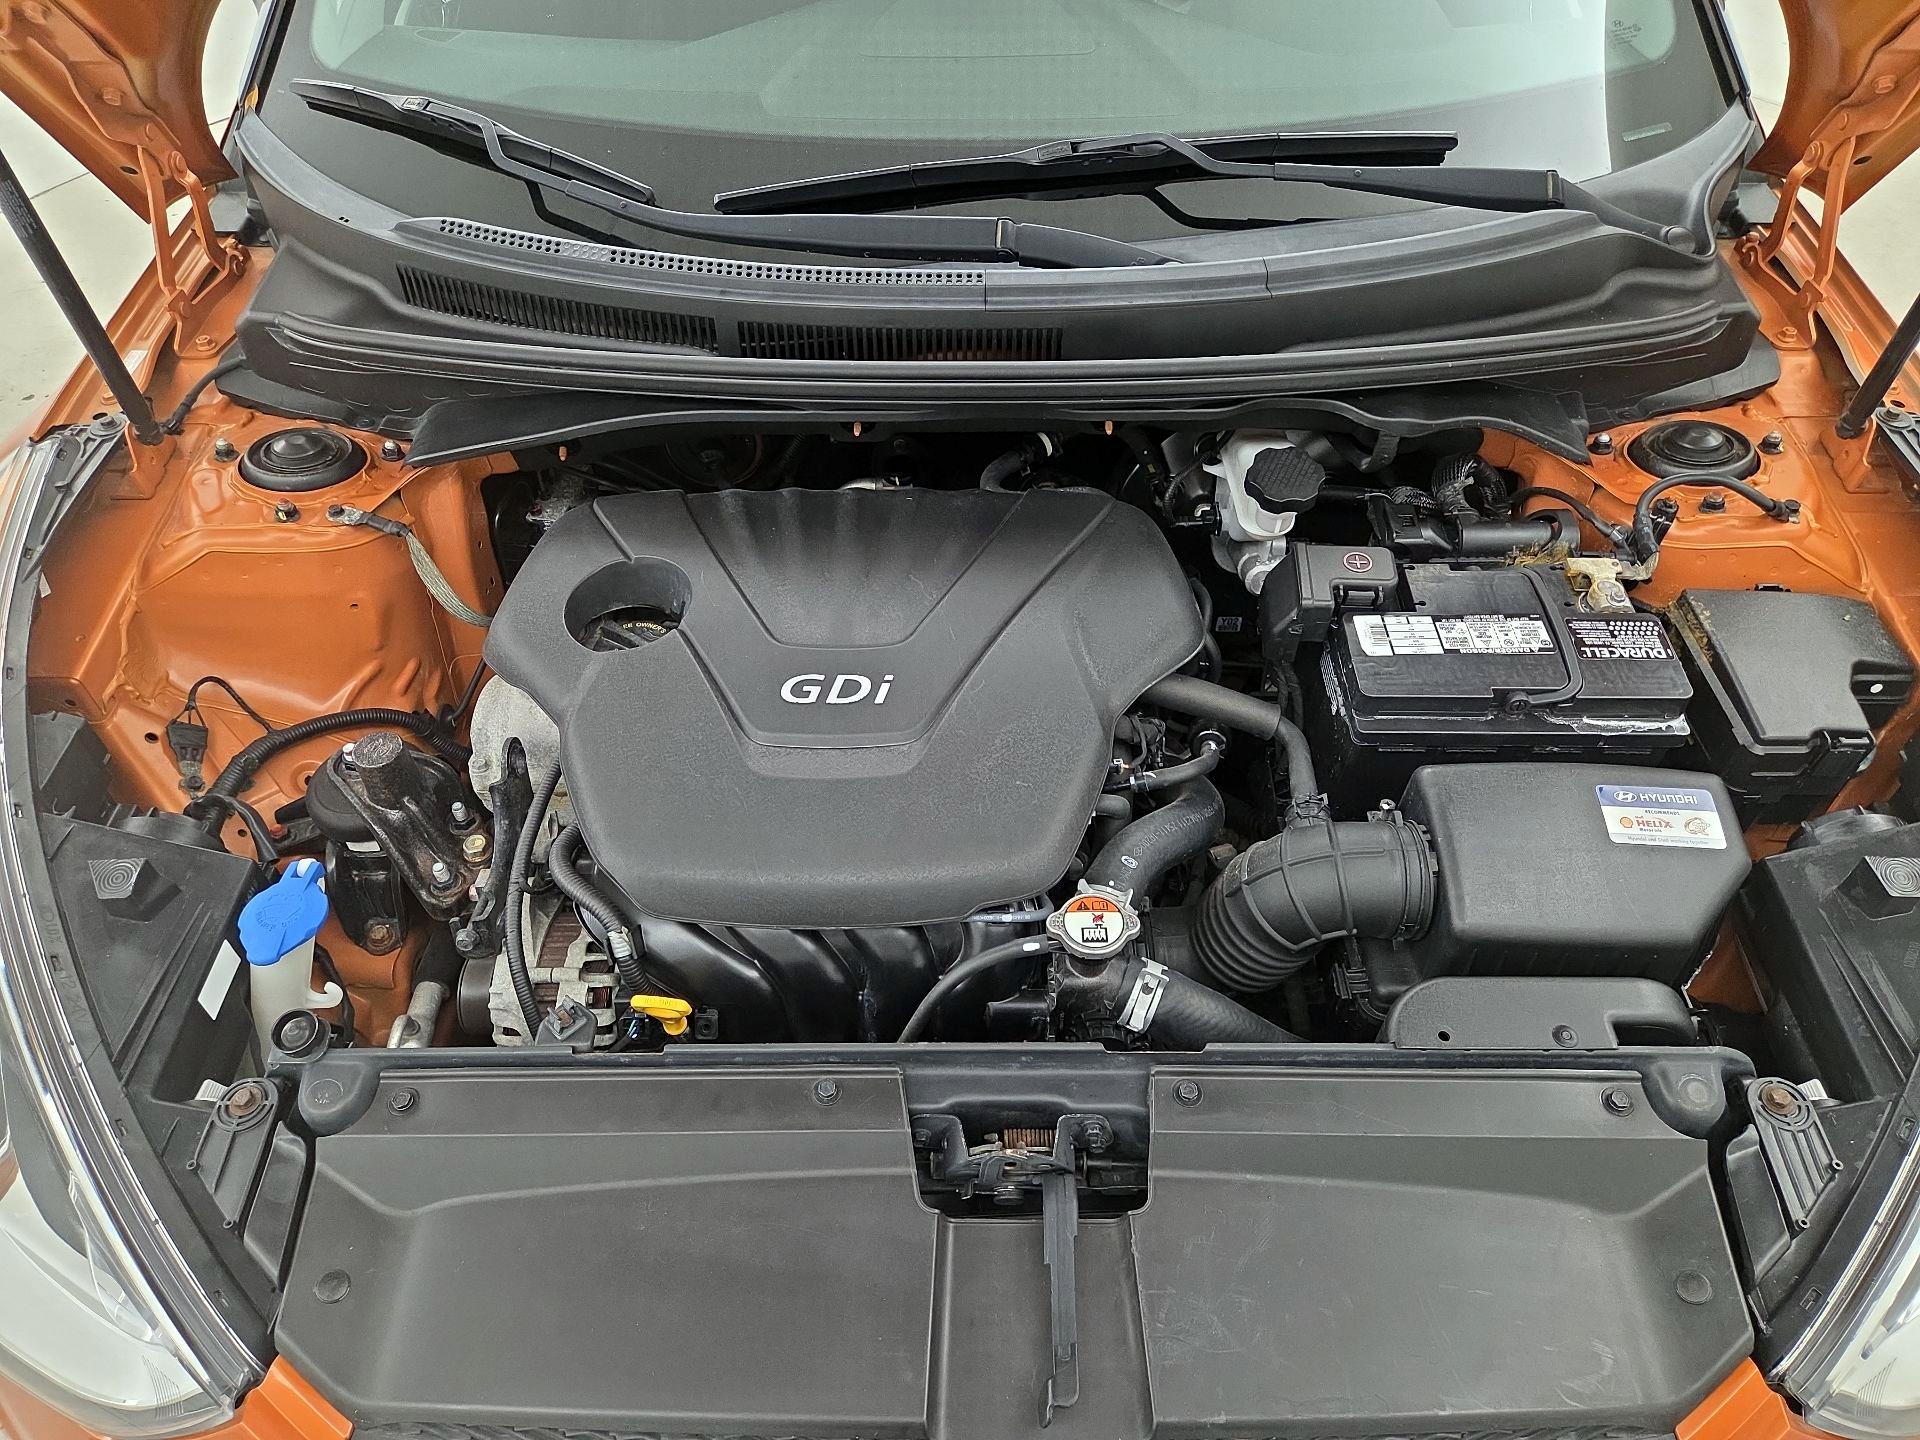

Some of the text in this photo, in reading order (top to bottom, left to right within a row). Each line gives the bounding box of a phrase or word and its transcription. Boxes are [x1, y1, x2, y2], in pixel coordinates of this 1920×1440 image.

[635, 622, 666, 634] OWNER'S
[1580, 647, 1668, 658] DURACELL
[780, 673, 894, 704] GDi
[1640, 793, 1698, 804] HYUNDAI
[1636, 819, 1674, 829] HELIX
